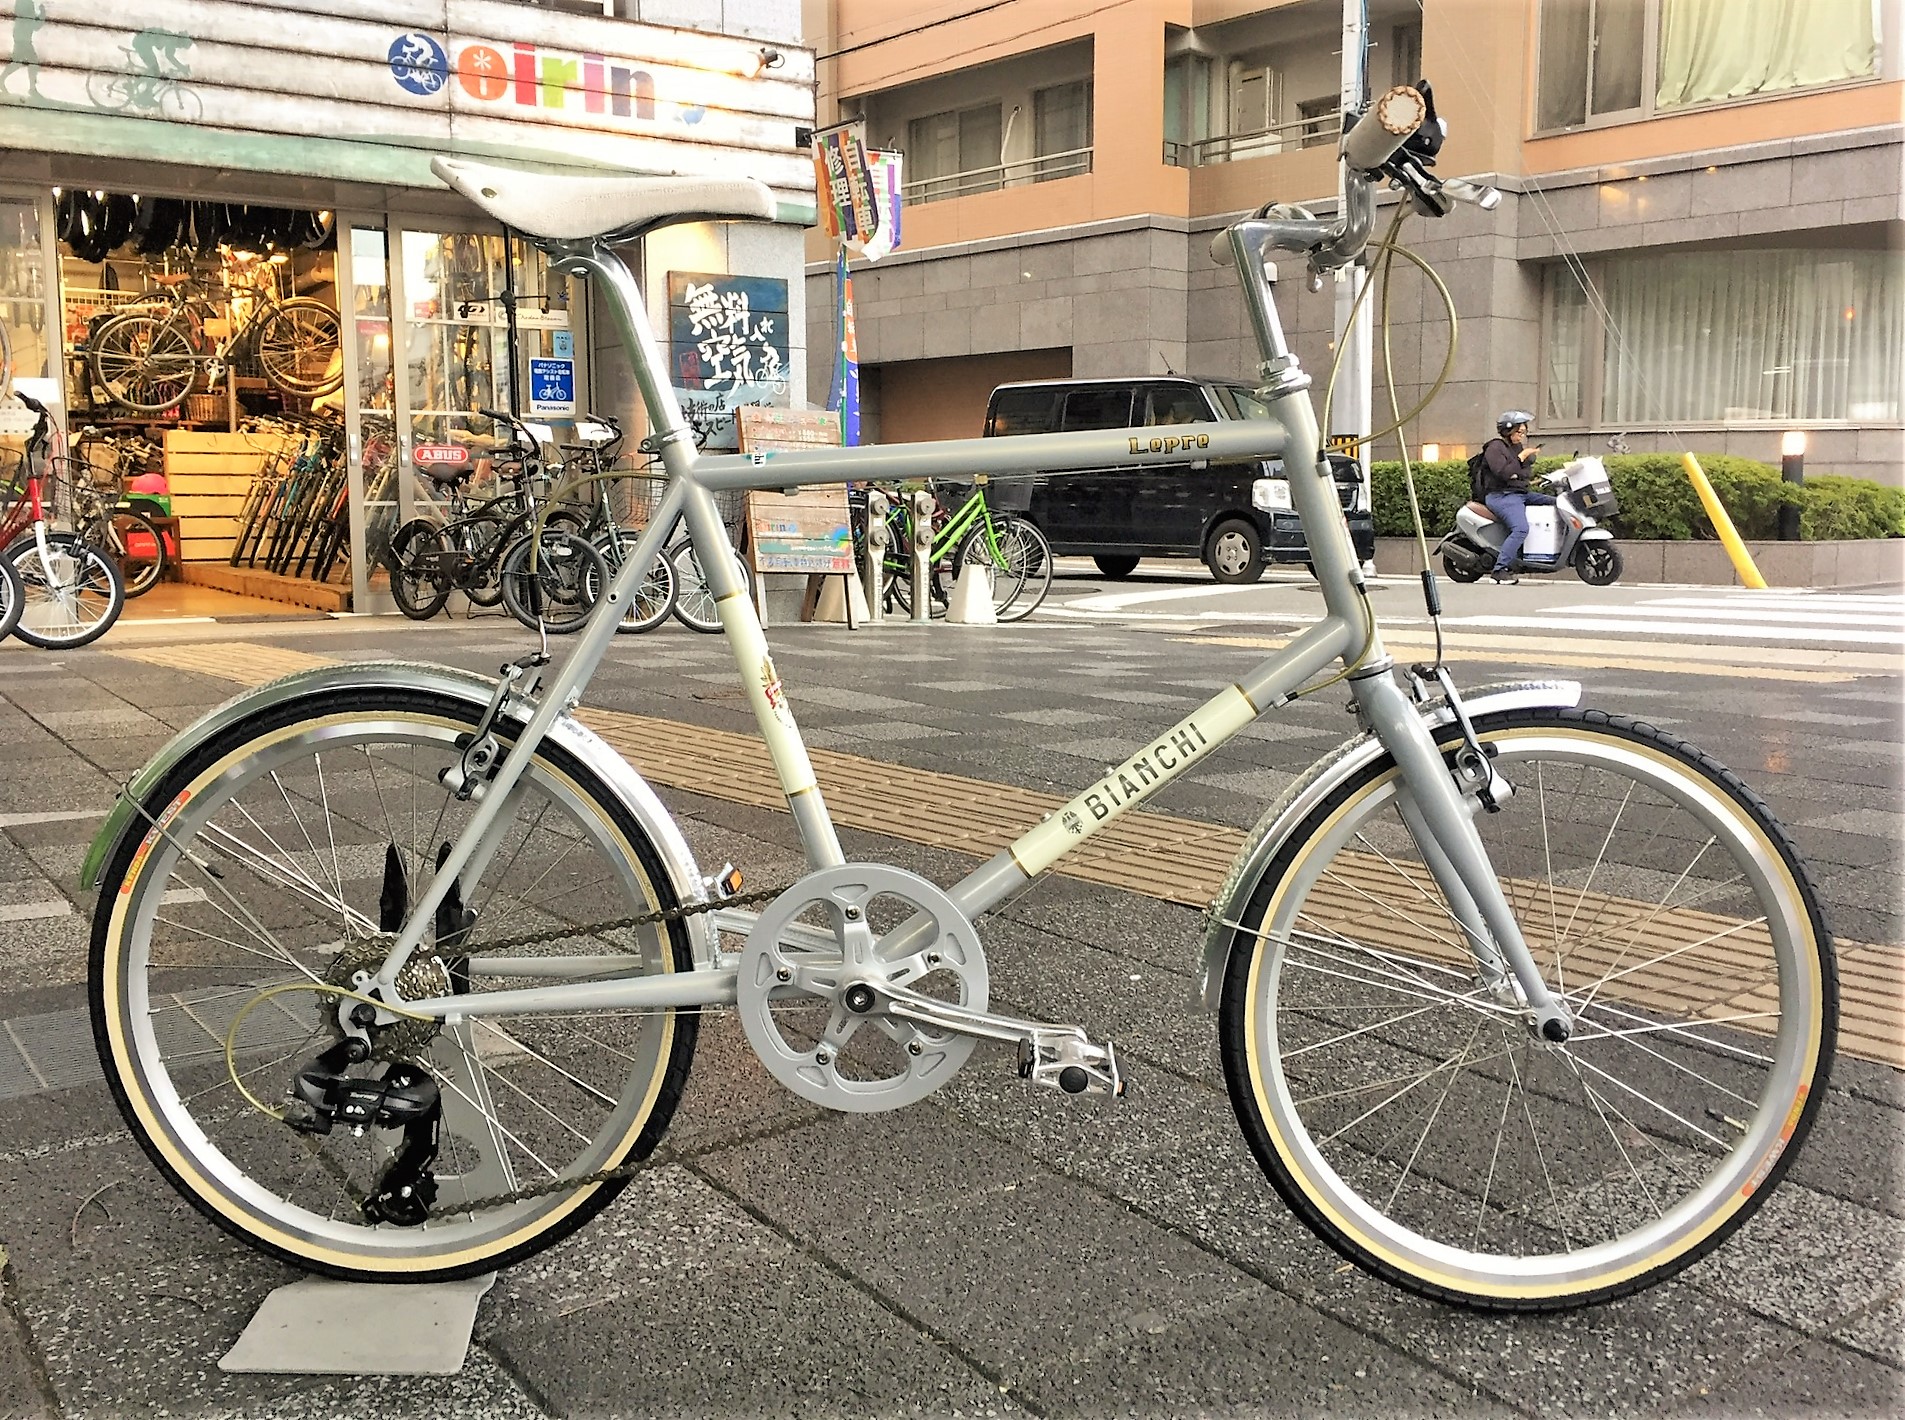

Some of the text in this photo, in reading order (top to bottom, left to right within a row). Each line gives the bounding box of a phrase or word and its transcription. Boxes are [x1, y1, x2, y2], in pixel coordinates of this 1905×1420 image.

[457, 41, 655, 121] oirin
[828, 145, 853, 207] 修理
[845, 140, 876, 232] 自転車
[685, 283, 750, 336] 無料
[697, 329, 755, 399] 空気
[536, 404, 570, 412] Panasonic
[420, 449, 462, 460] ABUS
[1128, 433, 1210, 455] Lepre
[1083, 721, 1208, 822] BIANCHI
